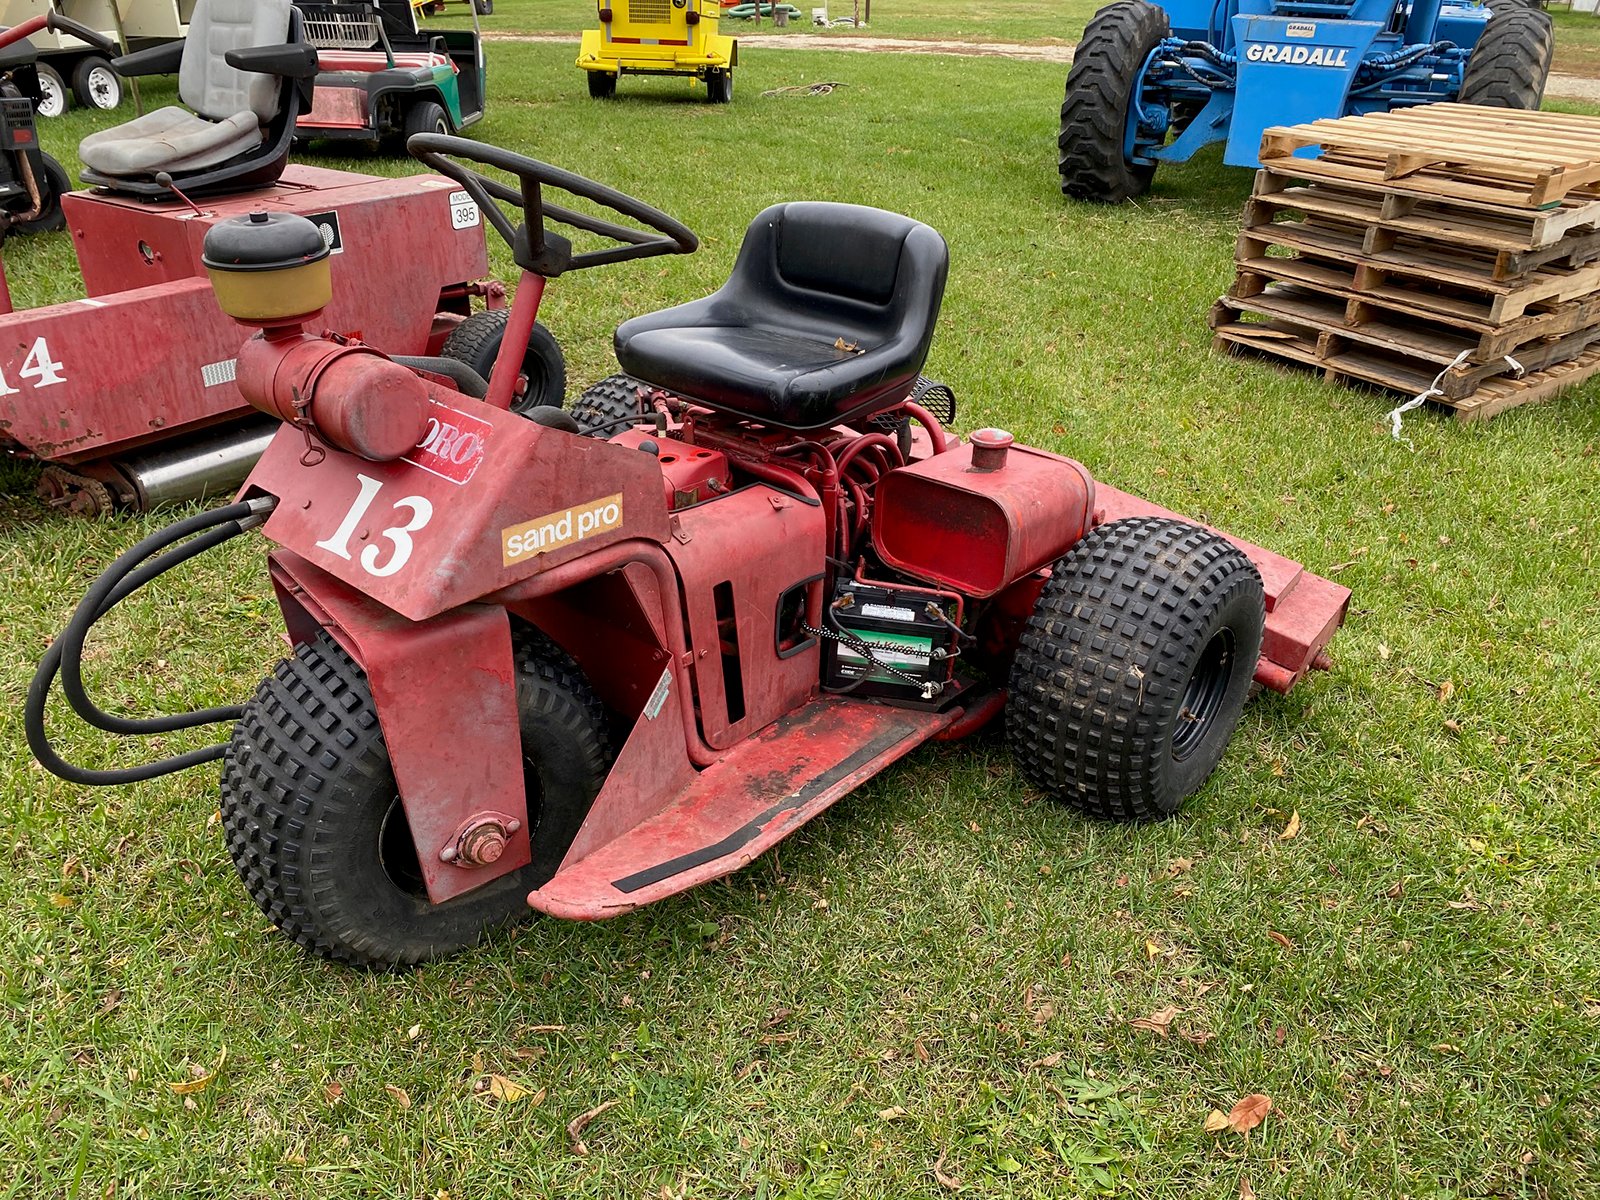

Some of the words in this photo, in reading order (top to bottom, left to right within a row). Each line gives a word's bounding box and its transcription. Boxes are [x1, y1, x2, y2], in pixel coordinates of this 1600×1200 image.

[1246, 44, 1347, 67] GRADALL
[453, 193, 471, 202] MODE
[456, 207, 475, 223] 395
[314, 472, 434, 577] 13
[506, 510, 572, 558] sand
[577, 503, 619, 540] pro
